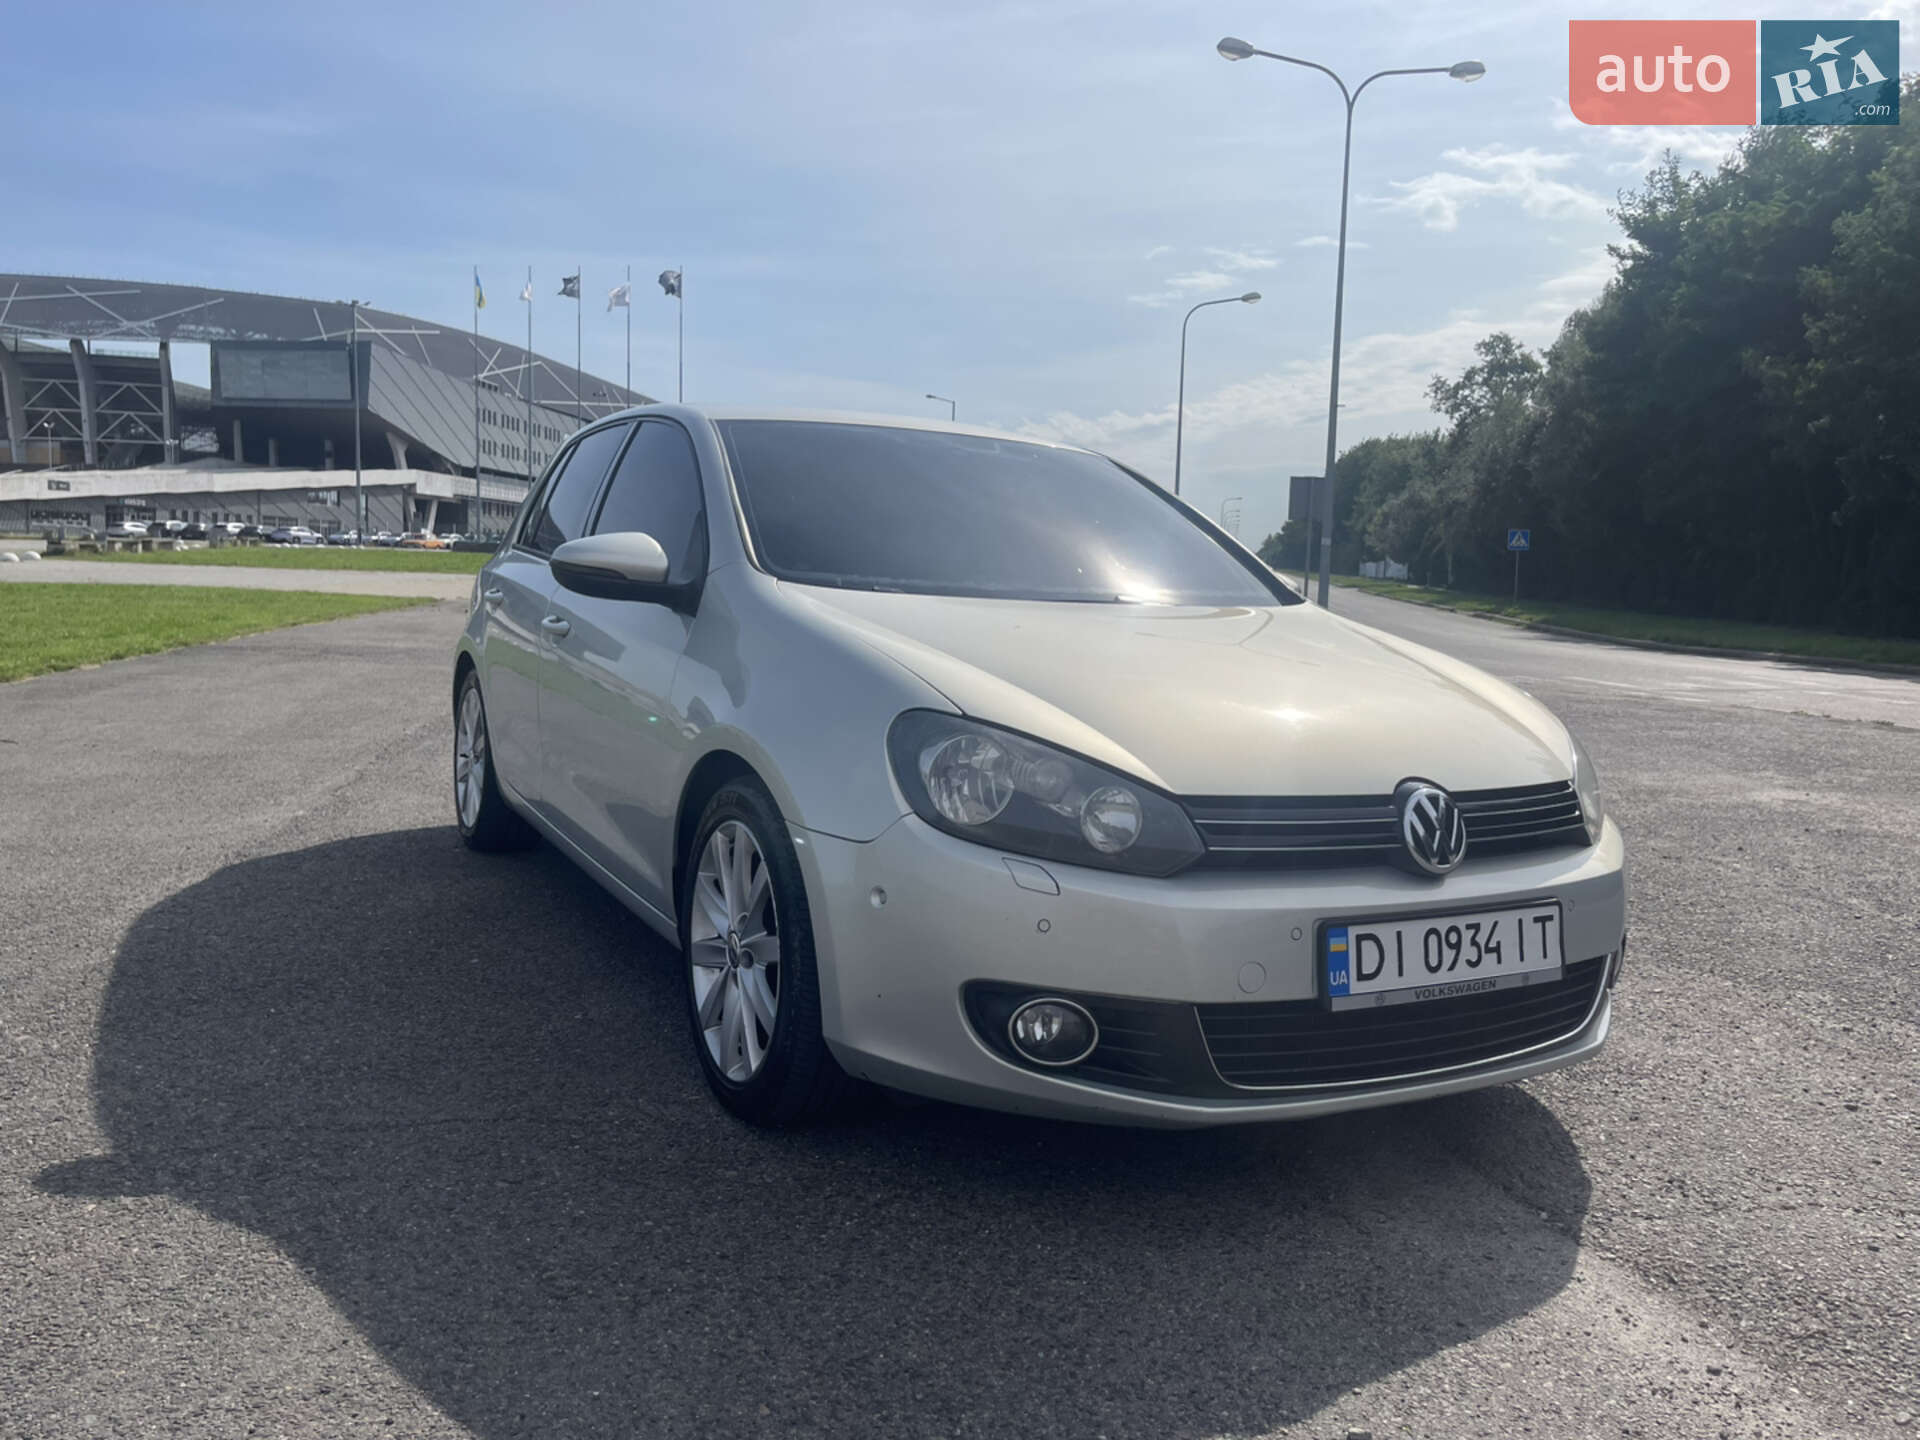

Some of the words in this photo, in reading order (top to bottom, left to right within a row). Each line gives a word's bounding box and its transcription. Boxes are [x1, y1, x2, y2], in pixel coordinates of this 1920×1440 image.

[1355, 930, 1404, 982] DI
[1424, 920, 1502, 973] 0934
[1518, 914, 1554, 962] IT
[1330, 970, 1348, 985] UA
[1414, 979, 1497, 1000] VOLKSWAGEN
